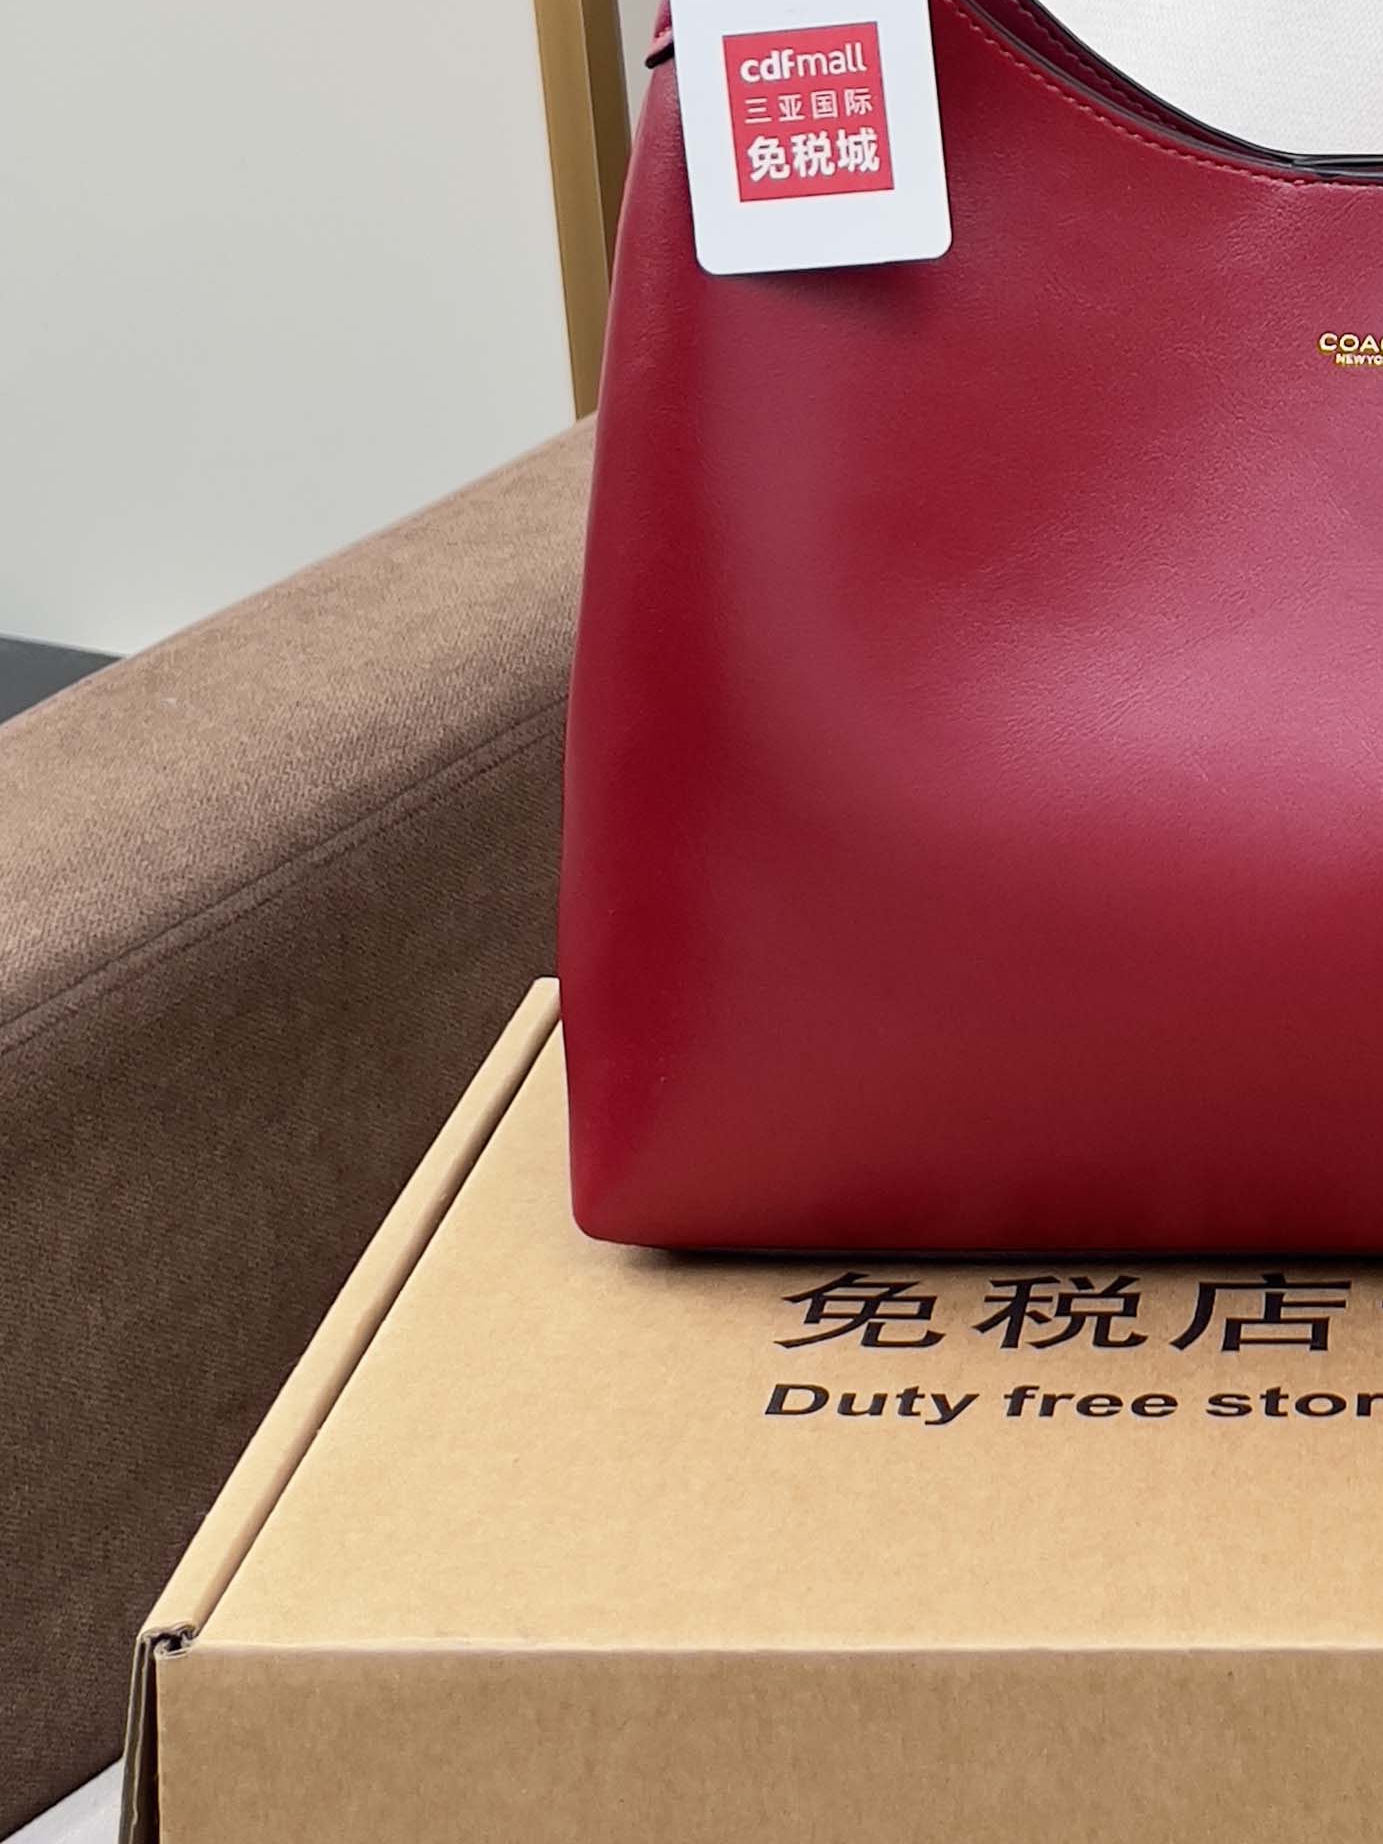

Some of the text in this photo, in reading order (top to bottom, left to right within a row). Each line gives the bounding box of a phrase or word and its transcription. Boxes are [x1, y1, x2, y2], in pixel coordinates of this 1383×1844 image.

[740, 42, 867, 83] cdfmall
[744, 87, 874, 124] 三亚国际
[747, 126, 881, 182] 免税城
[764, 1383, 980, 1426] Duty
[1005, 1384, 1178, 1418] free
